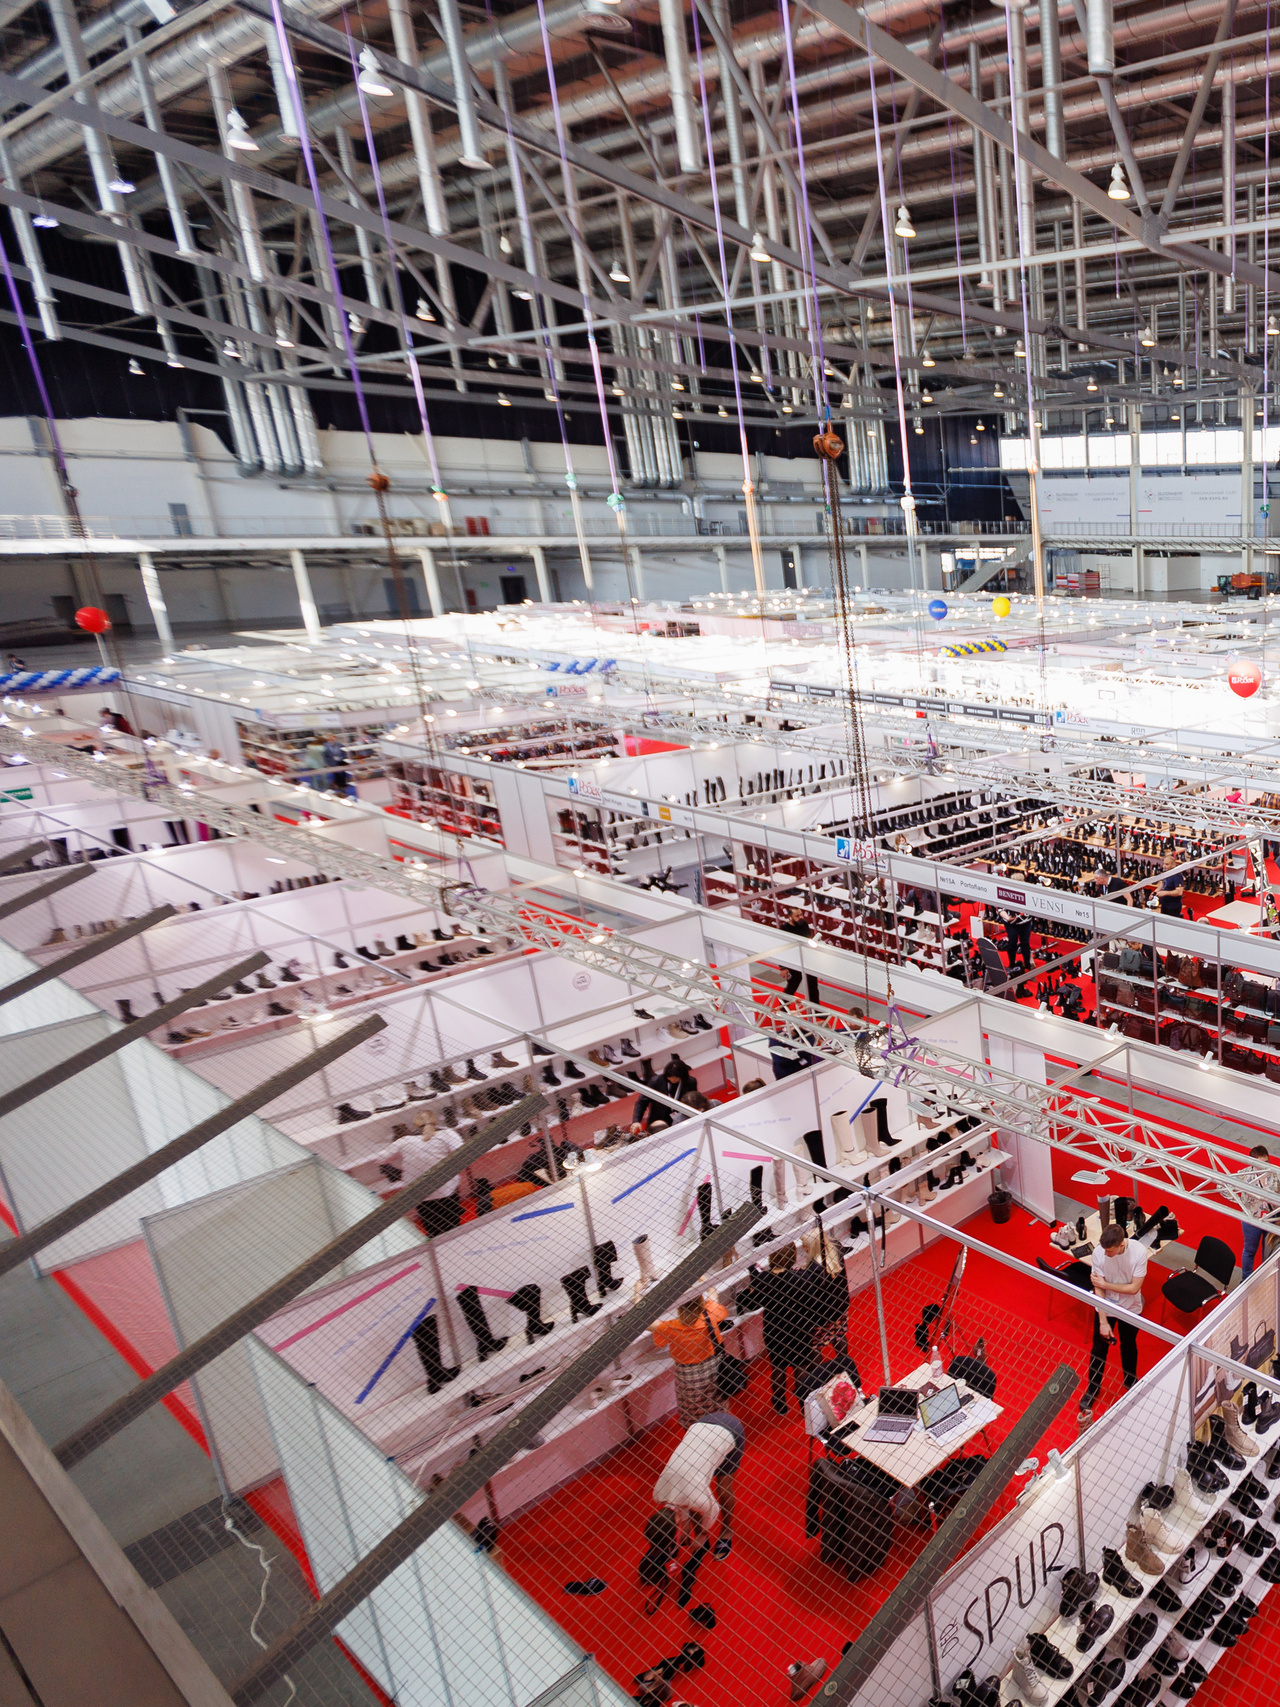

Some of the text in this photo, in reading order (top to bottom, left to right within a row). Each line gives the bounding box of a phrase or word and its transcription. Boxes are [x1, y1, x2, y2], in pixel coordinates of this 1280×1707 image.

[1032, 897, 1065, 914] VENSI
[1075, 909, 1090, 919] №15
[963, 1522, 1065, 1669] SPUR
